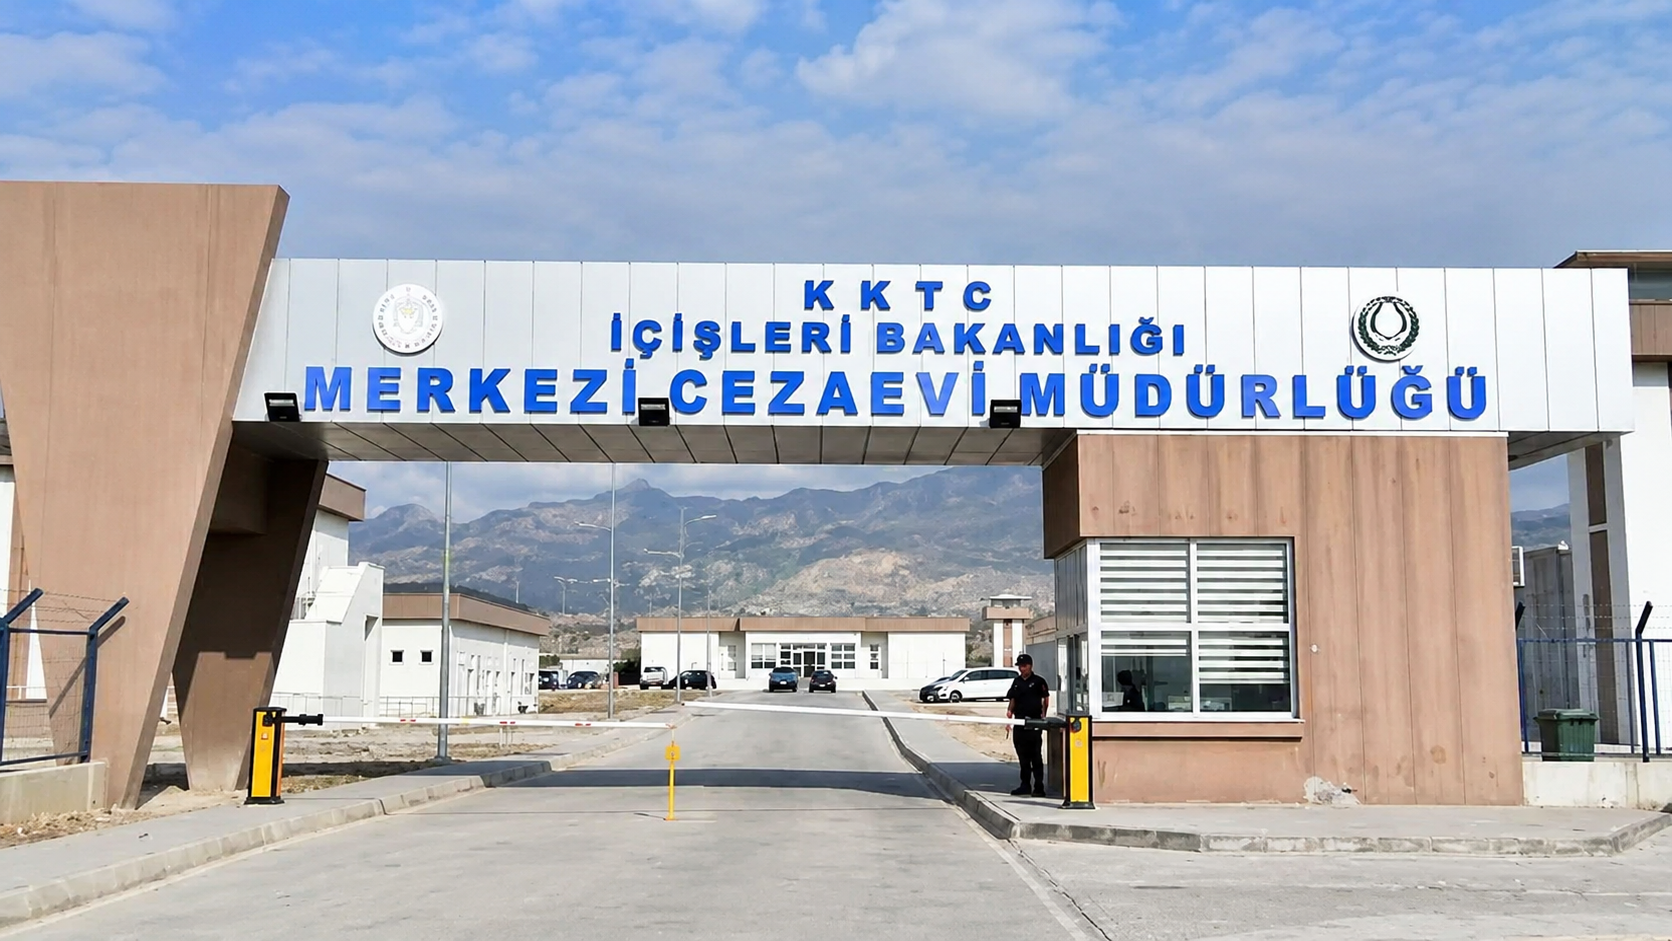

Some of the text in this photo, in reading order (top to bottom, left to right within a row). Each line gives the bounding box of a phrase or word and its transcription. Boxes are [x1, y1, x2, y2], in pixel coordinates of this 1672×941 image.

[611, 312, 1185, 360] İÇİŞLERİ BAKANLIĞI
[304, 357, 1487, 420] MERKEZİ CEZAEVİ MÜDÜRLÜĞÜ
